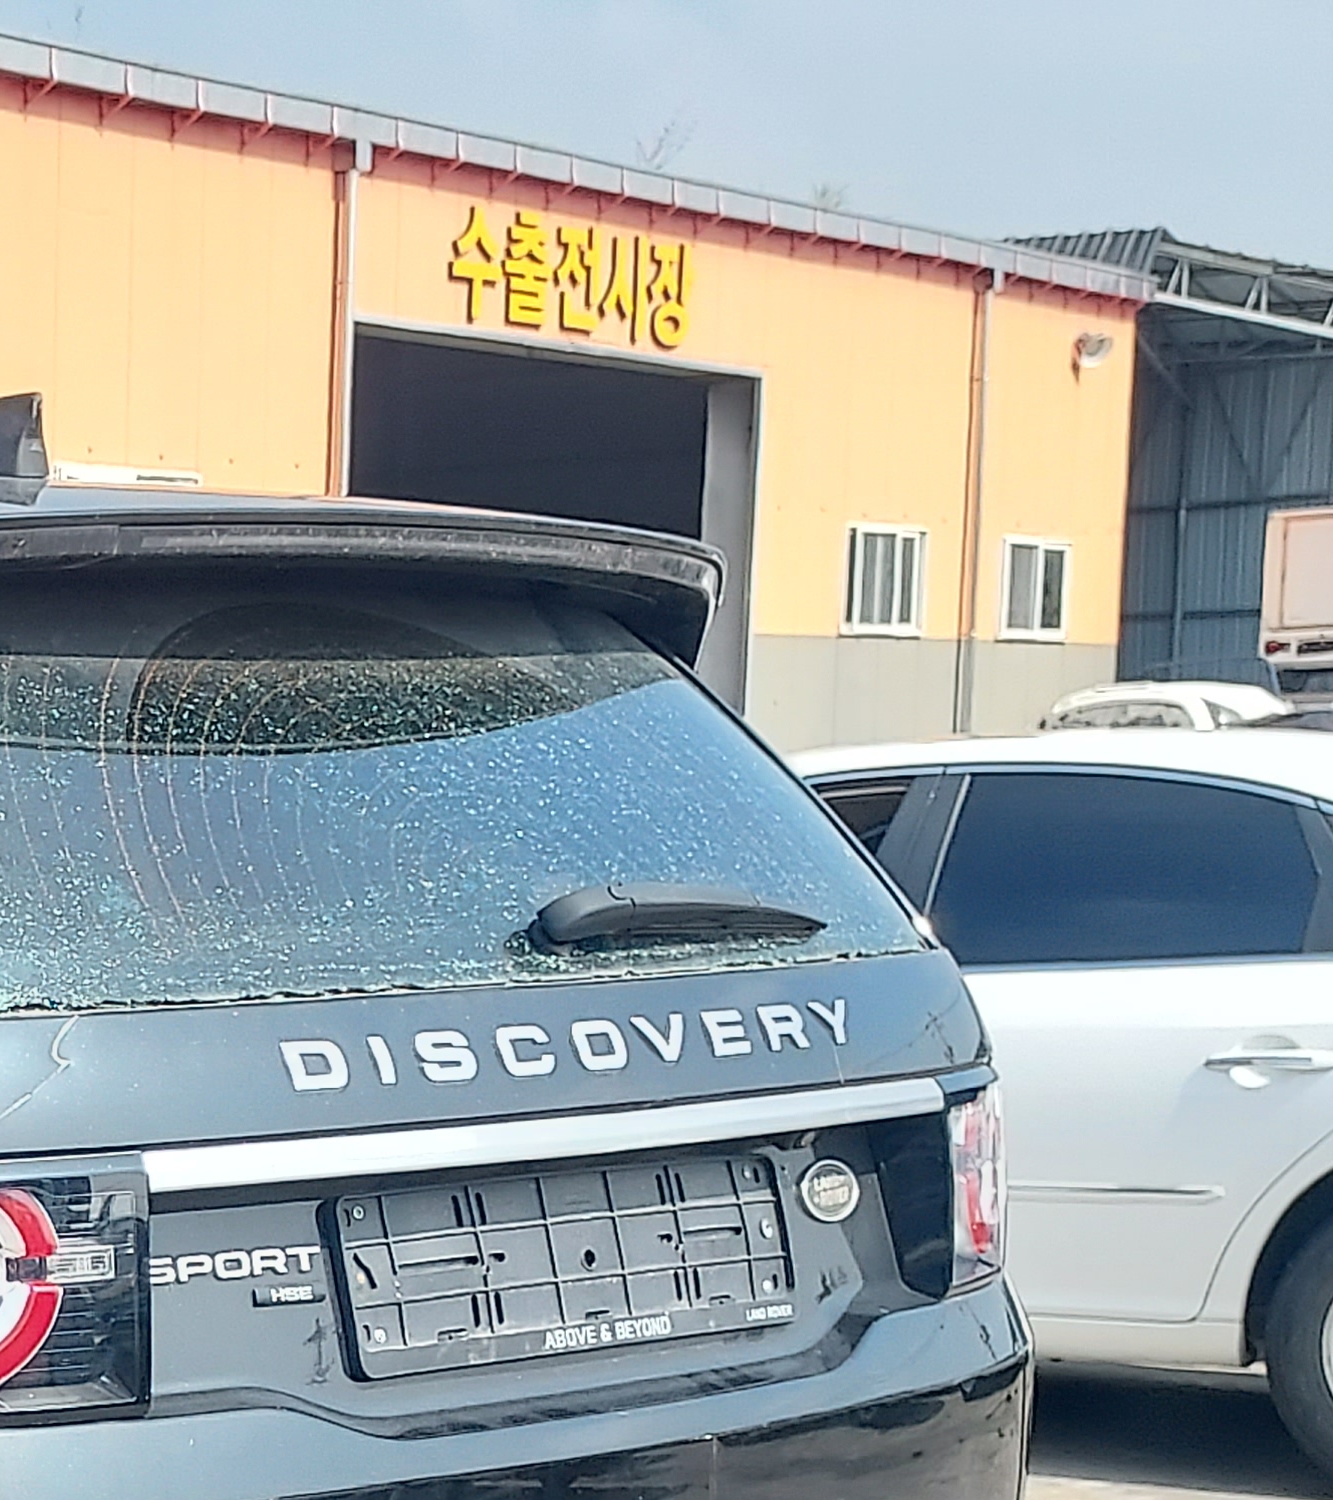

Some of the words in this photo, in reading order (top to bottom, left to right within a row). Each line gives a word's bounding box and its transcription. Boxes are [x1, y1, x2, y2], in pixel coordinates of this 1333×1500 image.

[449, 204, 694, 348] 수출전시장
[278, 998, 848, 1091] DISCOVERY
[149, 1244, 321, 1285] SPORT
[269, 1285, 314, 1303] HSE
[745, 1306, 766, 1322] LAND
[766, 1304, 794, 1318] ROVER
[544, 1325, 598, 1350] ABOVE
[599, 1323, 613, 1342] &
[614, 1315, 672, 1341] BEYOND
